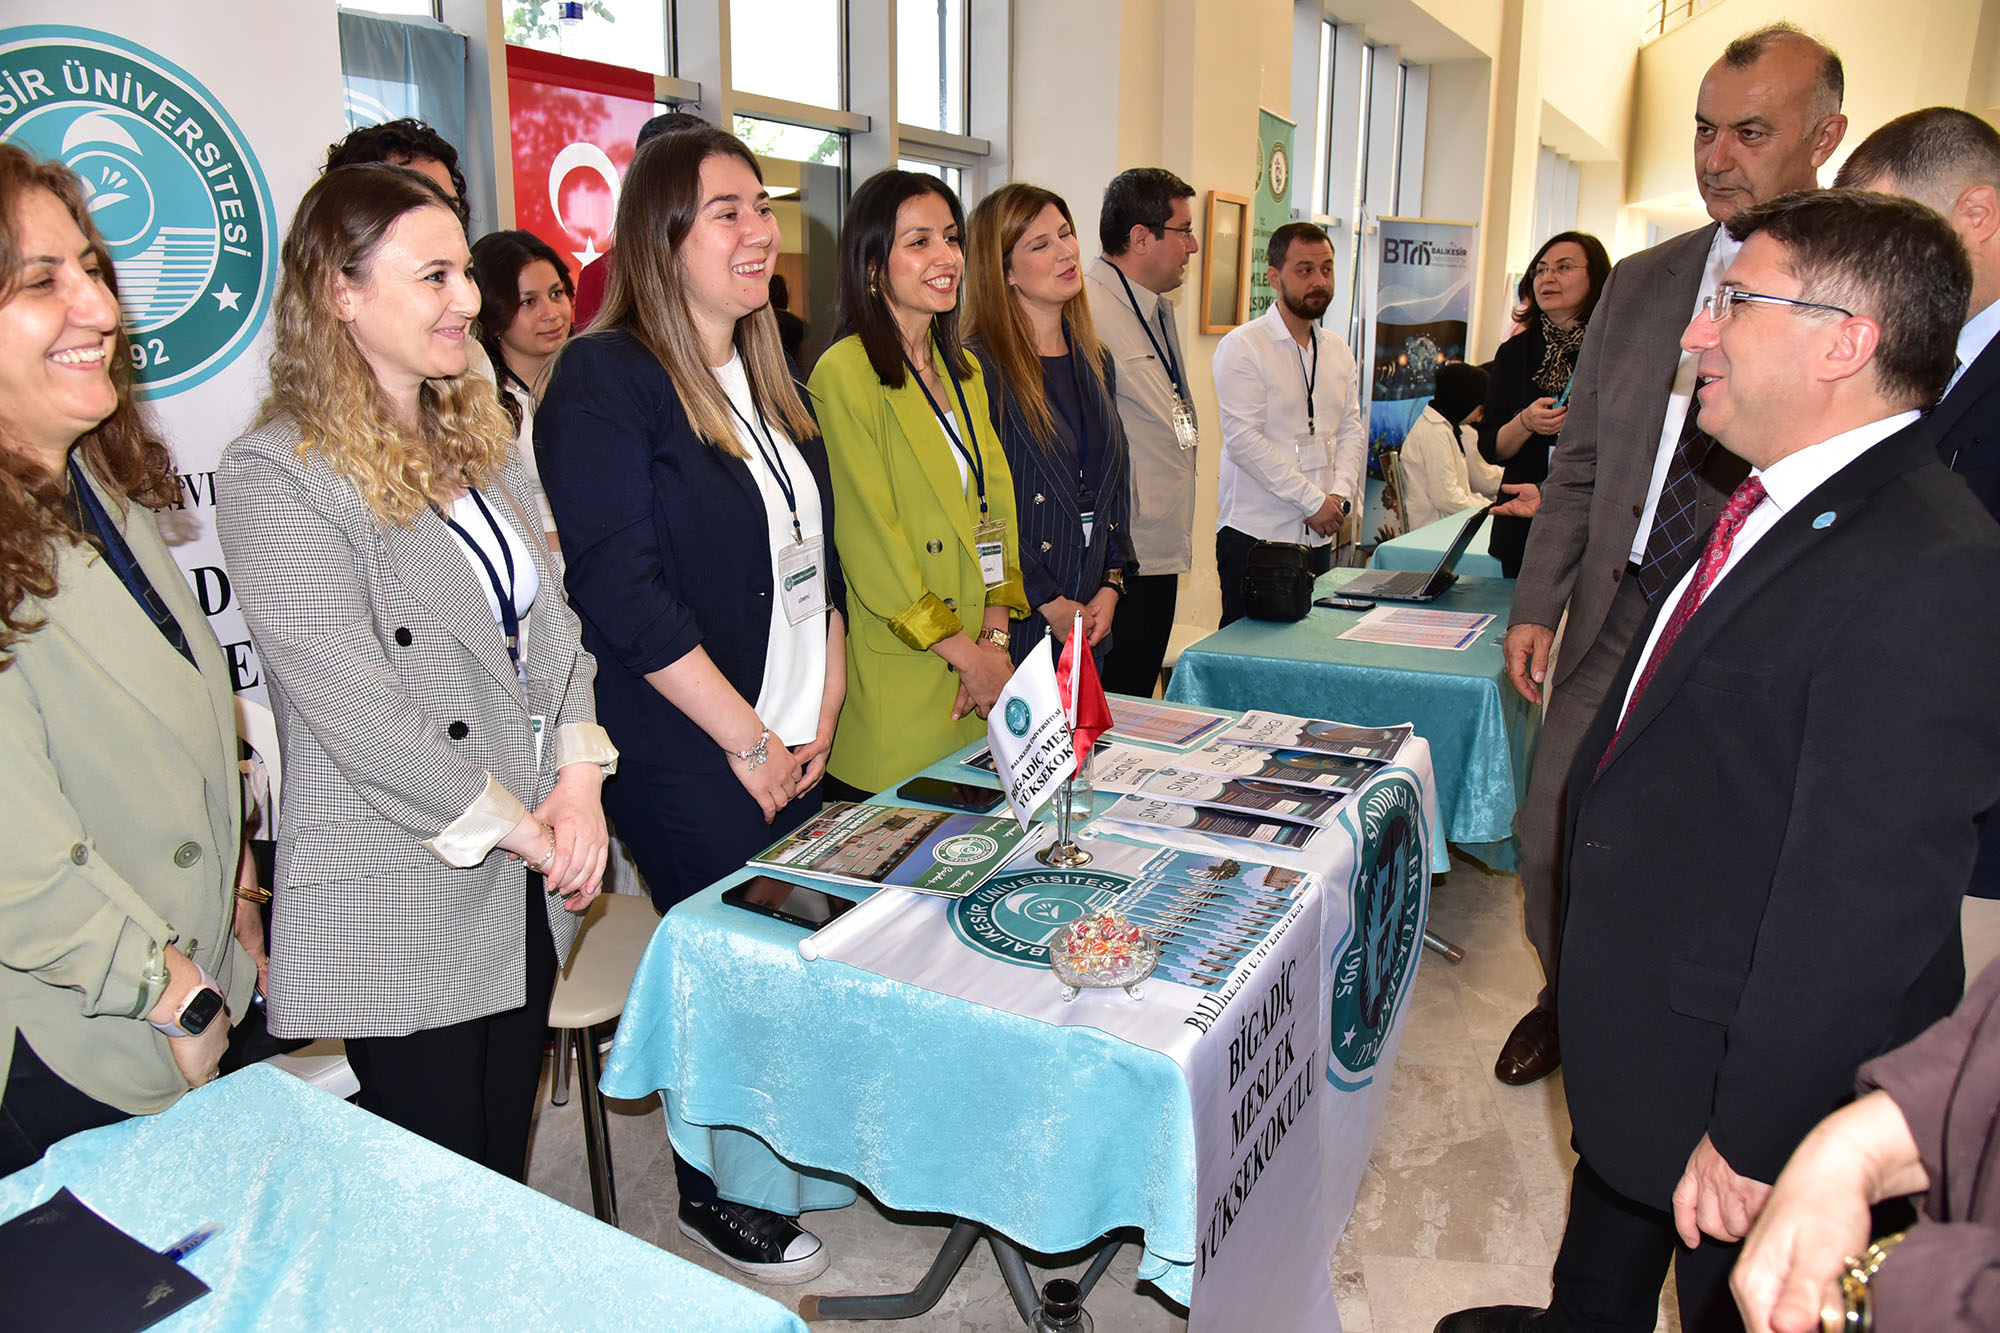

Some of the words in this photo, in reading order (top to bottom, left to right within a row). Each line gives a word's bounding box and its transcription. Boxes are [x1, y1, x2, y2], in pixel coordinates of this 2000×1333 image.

[62, 59, 252, 258] ÜNİVERSİTESİ
[1010, 752, 1044, 802] BİGADİÇ
[965, 903, 1046, 957] BALIKESİR
[976, 874, 1125, 904] ÜNİVERSİTESİ
[1336, 946, 1363, 1000] 1995
[1228, 959, 1297, 1093] BİGADİÇ
[1231, 1020, 1296, 1158] MESLEK
[1200, 1050, 1316, 1283] YÜKSEKOKULU
